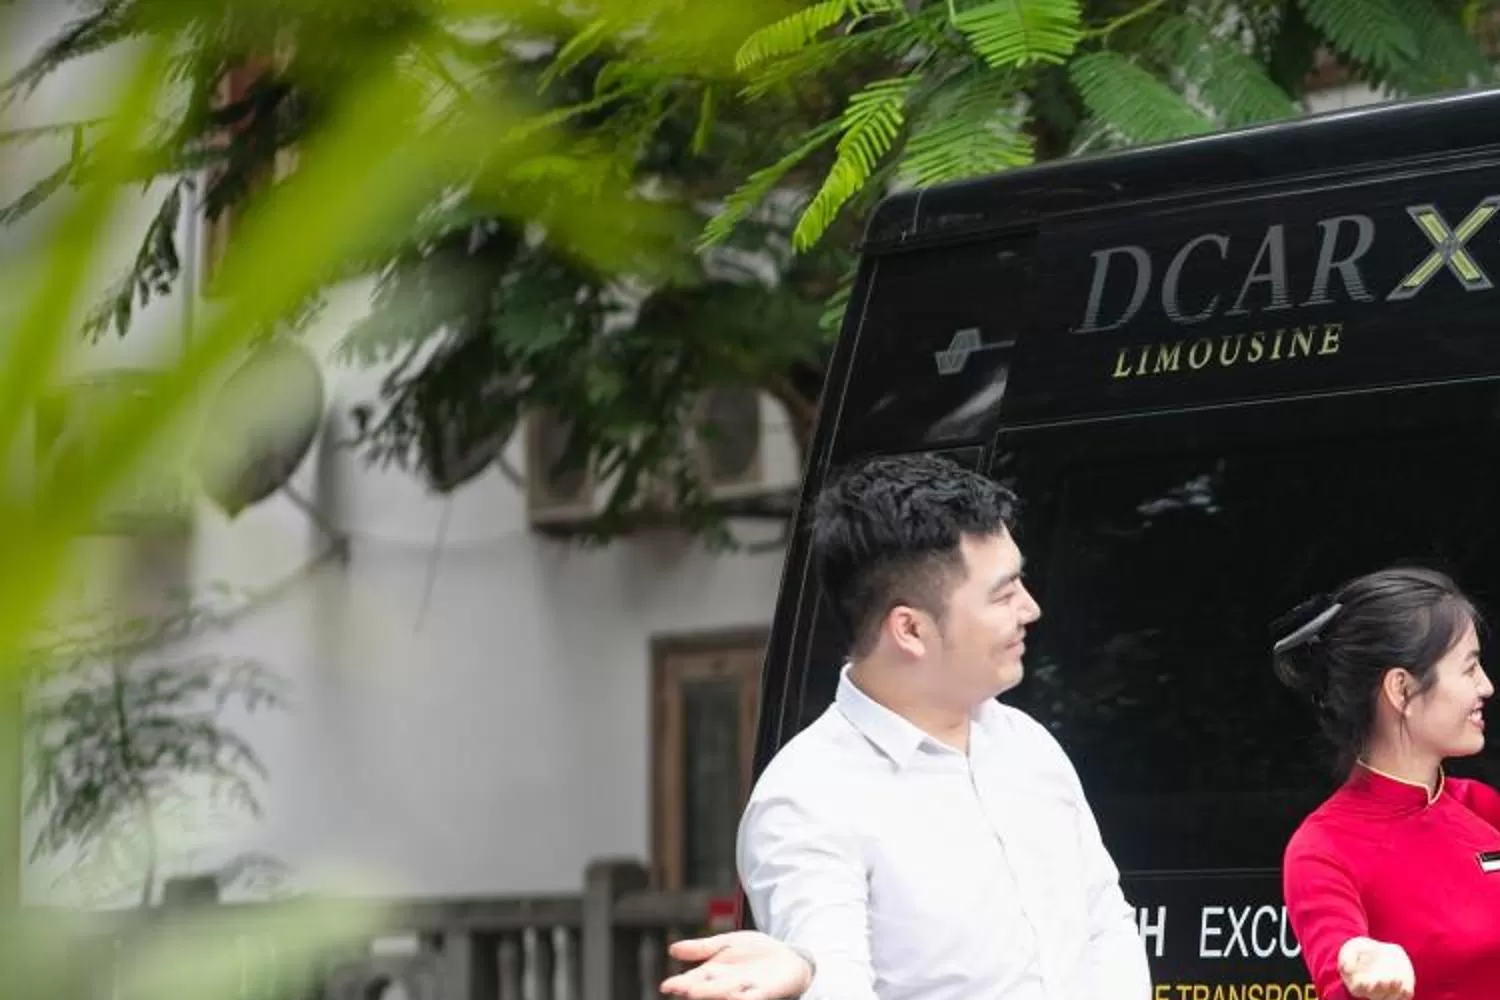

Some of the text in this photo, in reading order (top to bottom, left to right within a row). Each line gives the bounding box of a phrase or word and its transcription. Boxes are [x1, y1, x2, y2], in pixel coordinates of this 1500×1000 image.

[1069, 212, 1376, 334] DCAR
[1112, 322, 1345, 378] LIMOUSINE
[1139, 905, 1301, 958] H EXCU
